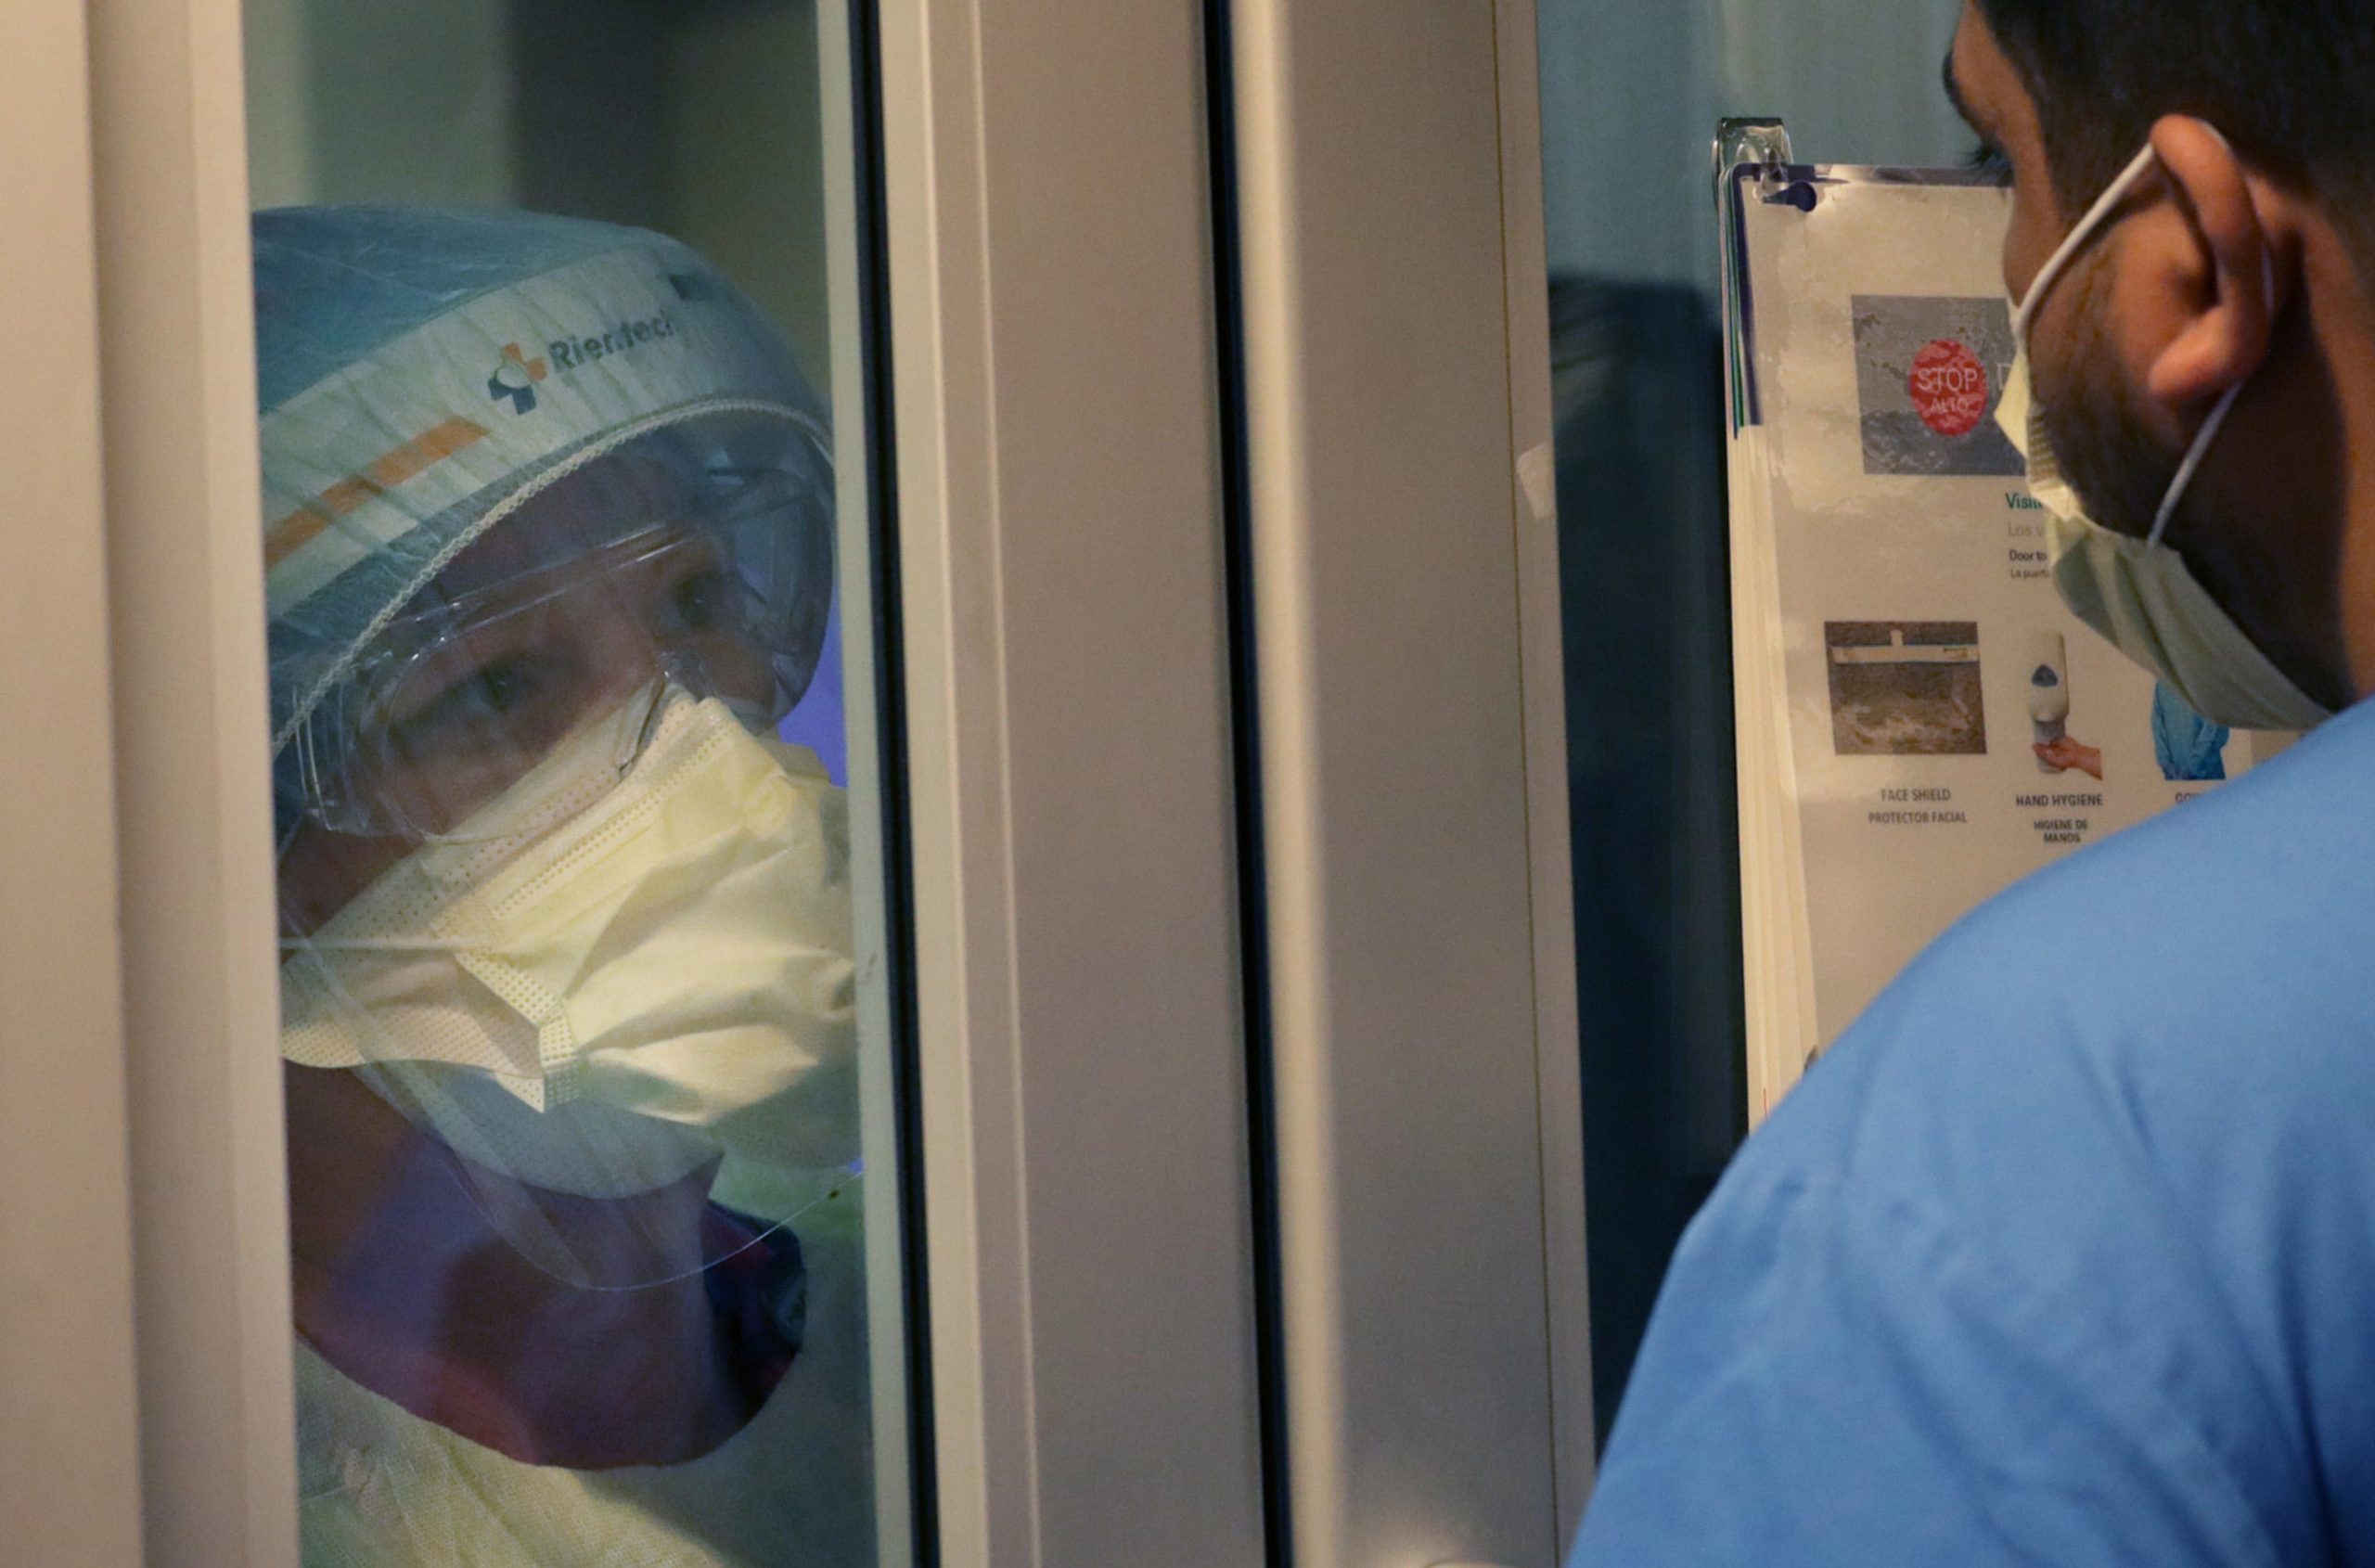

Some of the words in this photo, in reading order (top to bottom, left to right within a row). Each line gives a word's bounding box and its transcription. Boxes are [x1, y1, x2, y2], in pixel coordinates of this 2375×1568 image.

[1916, 367, 1978, 392] STOP
[2009, 549, 2034, 561] Door
[2035, 551, 2048, 561] to
[1881, 789, 1909, 802] FACE
[1911, 789, 1951, 802] SHIELD
[2015, 794, 2049, 806] HAND
[2051, 793, 2103, 806] HYGIENE
[1868, 812, 1930, 824] PROTECTOR
[1931, 811, 1968, 823] FACIAL
[2034, 819, 2073, 830] HIGIENE
[2074, 819, 2087, 830] DE
[2043, 832, 2081, 843] MANOS
